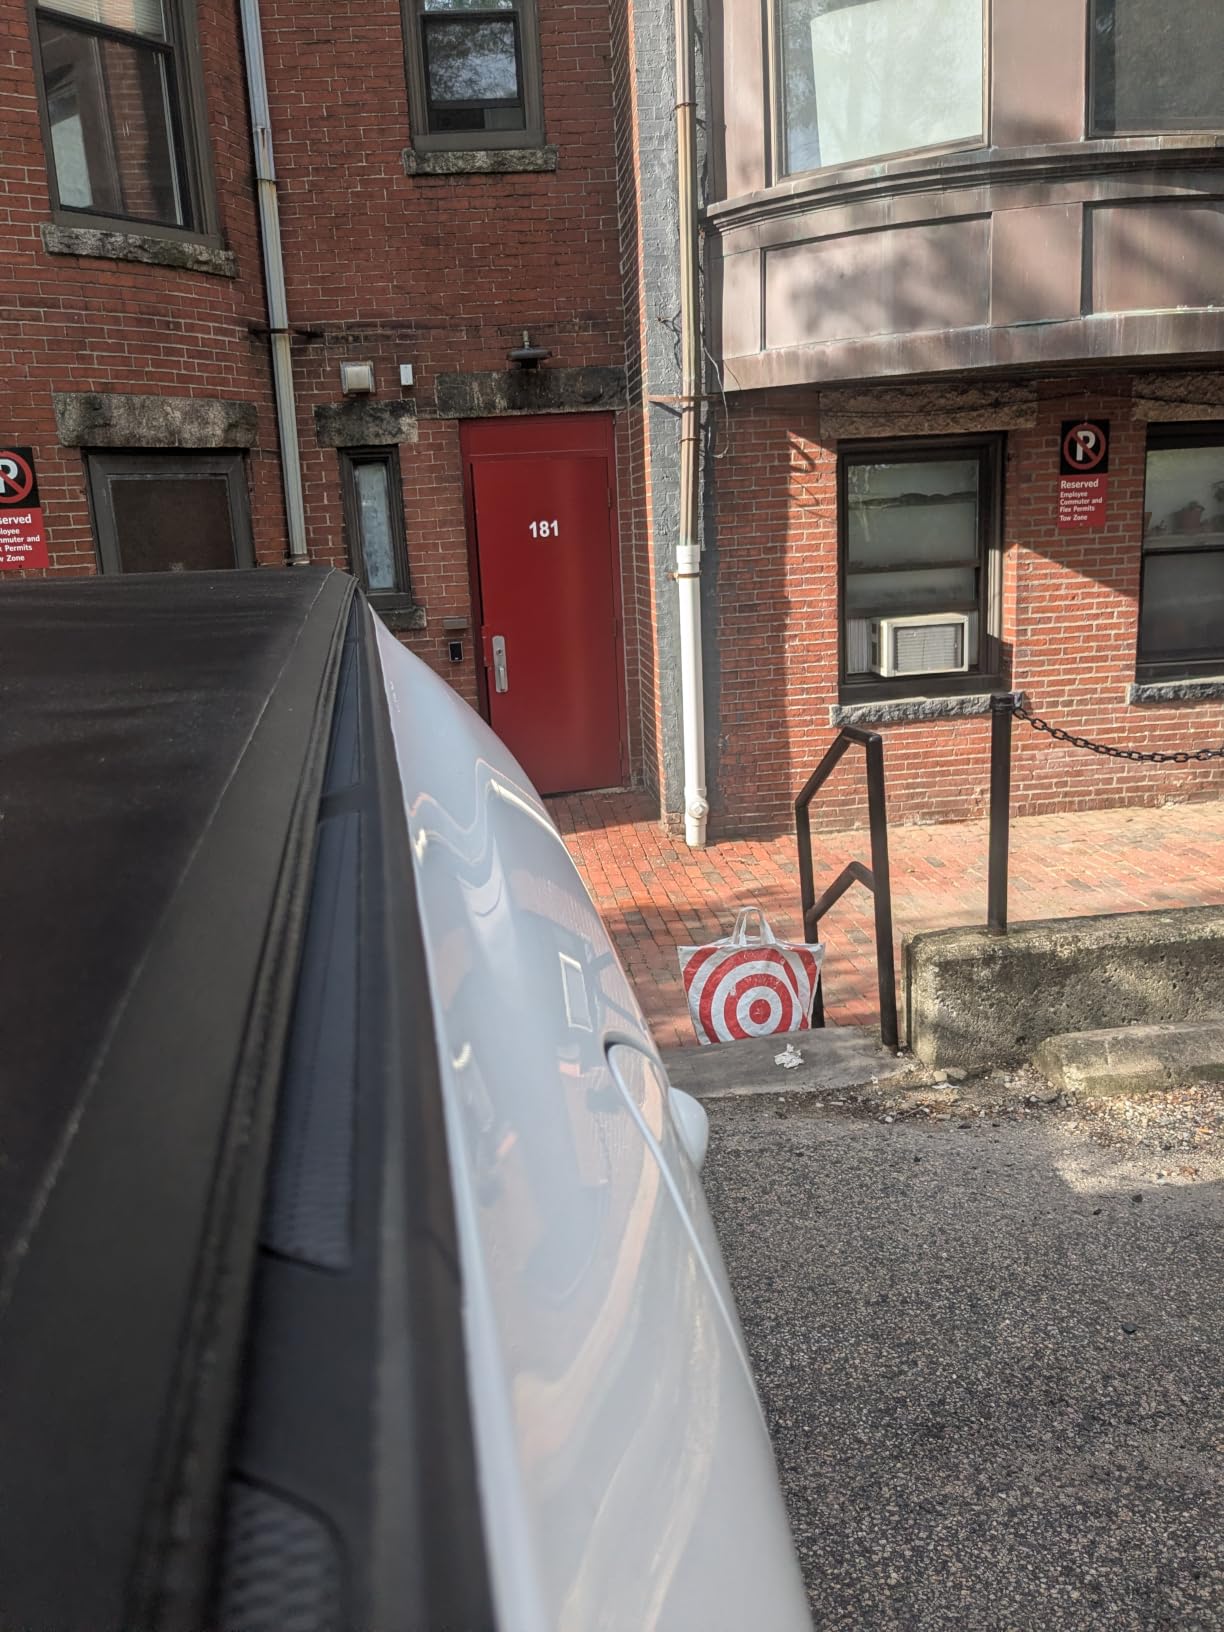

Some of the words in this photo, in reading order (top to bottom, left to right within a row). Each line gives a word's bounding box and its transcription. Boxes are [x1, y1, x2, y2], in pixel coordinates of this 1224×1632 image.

[1061, 478, 1099, 489] Reserved
[1060, 491, 1088, 499] Employee
[1092, 496, 1102, 504] and
[0, 513, 32, 524] served
[0, 528, 20, 536] loyee
[529, 519, 559, 538] 181
[26, 534, 40, 542] and
[4, 544, 32, 552] Permits
[7, 554, 25, 562] Zone
